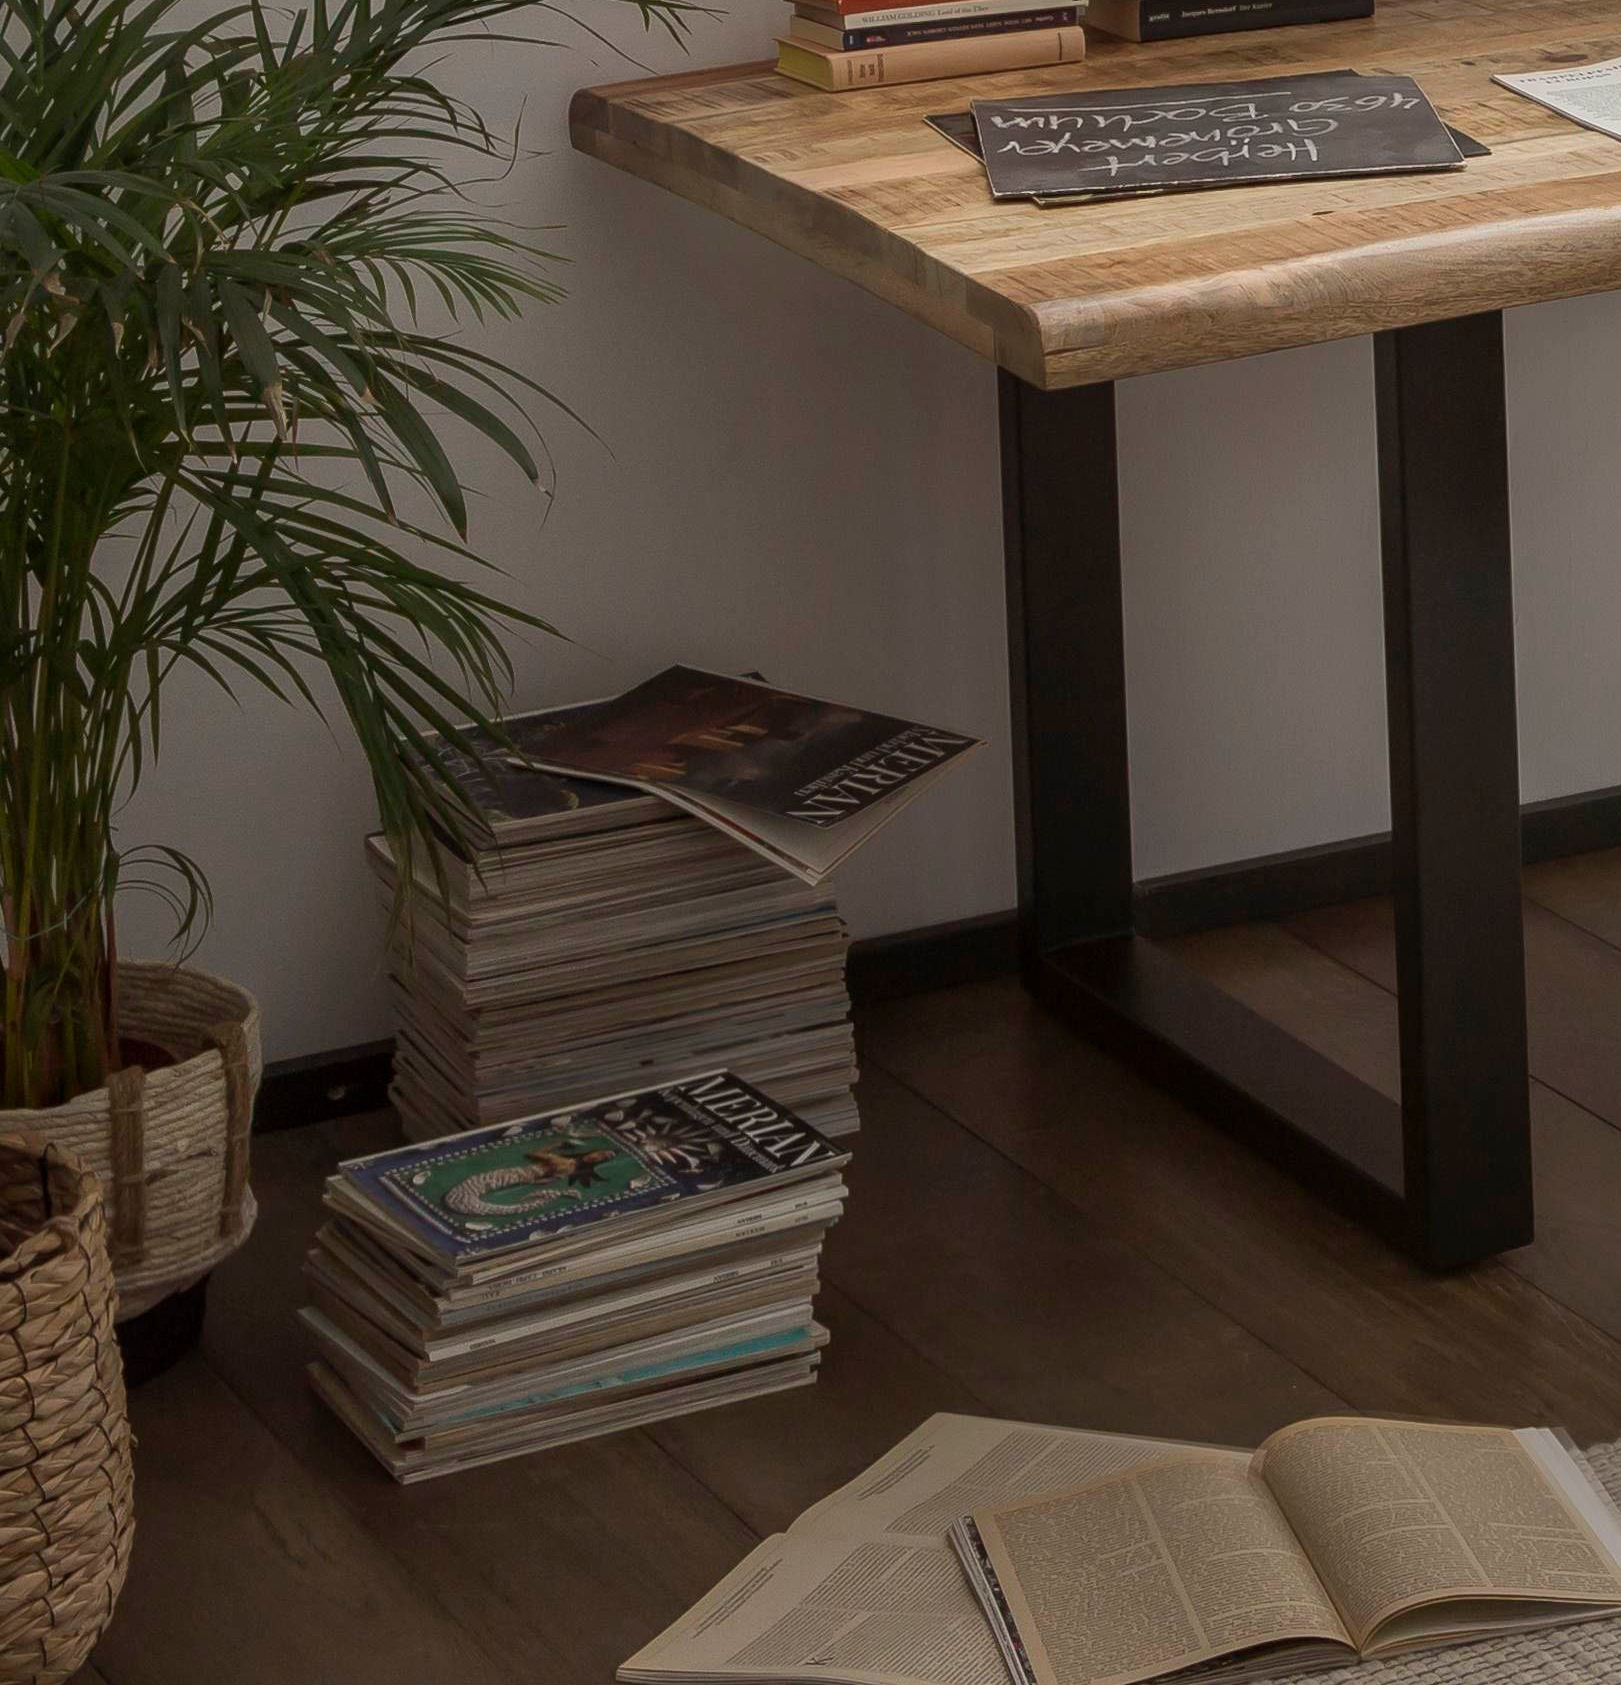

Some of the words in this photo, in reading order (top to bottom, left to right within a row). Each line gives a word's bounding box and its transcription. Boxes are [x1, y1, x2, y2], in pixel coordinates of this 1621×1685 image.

[992, 102, 1270, 131] Bochum
[1290, 93, 1421, 114] 4630
[997, 118, 1340, 158] Grönemeyer
[1078, 138, 1319, 177] Herbert
[785, 732, 967, 824] MERIAN
[678, 1076, 836, 1168] MERIAN
